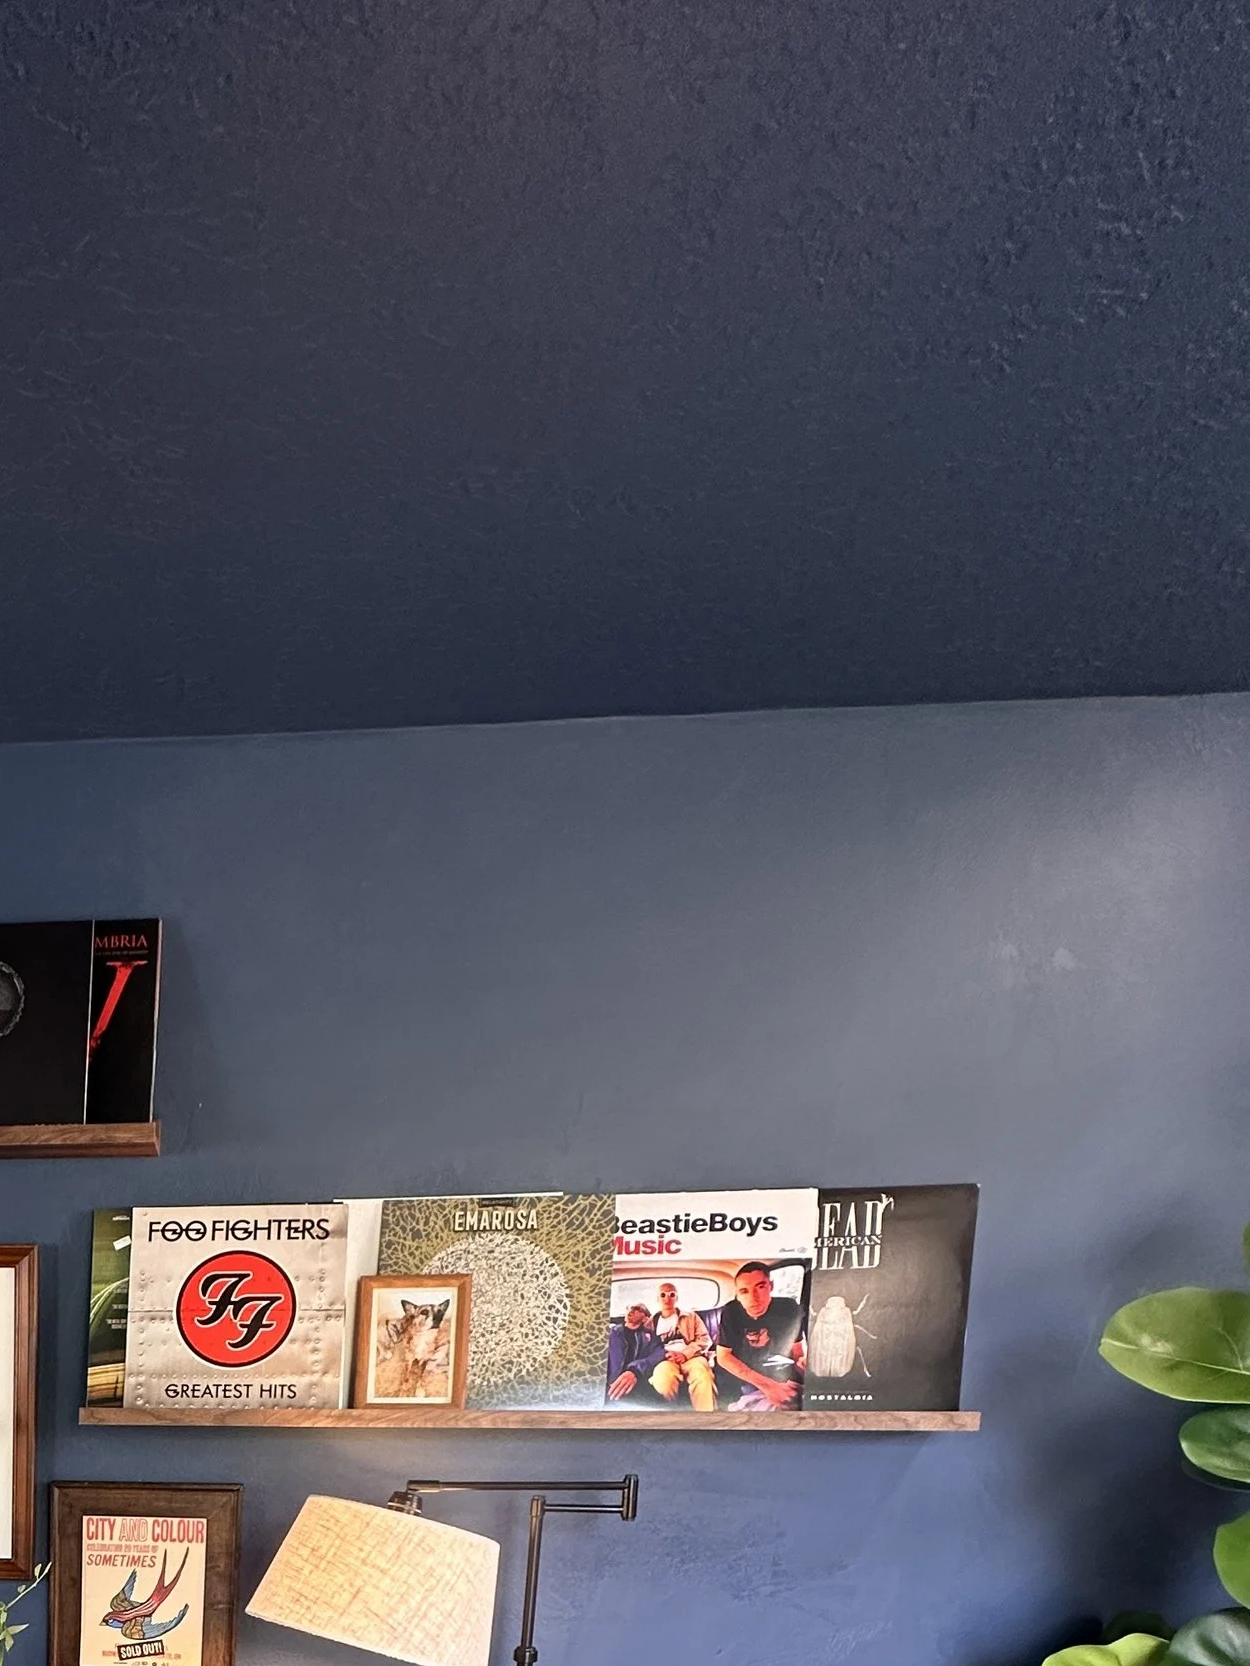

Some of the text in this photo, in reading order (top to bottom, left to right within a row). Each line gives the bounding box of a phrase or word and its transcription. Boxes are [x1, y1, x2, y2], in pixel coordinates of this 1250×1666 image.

[148, 1218, 330, 1242] FOO FIGHTERS
[454, 1209, 538, 1232] EMAROSA
[164, 1383, 297, 1399] GREATEST HITS
[86, 1517, 205, 1544] CITY AND COLOUR
[86, 1553, 157, 1568] SOMETIMES
[120, 1644, 142, 1659] SOLD
[142, 1641, 163, 1656] OUT!
